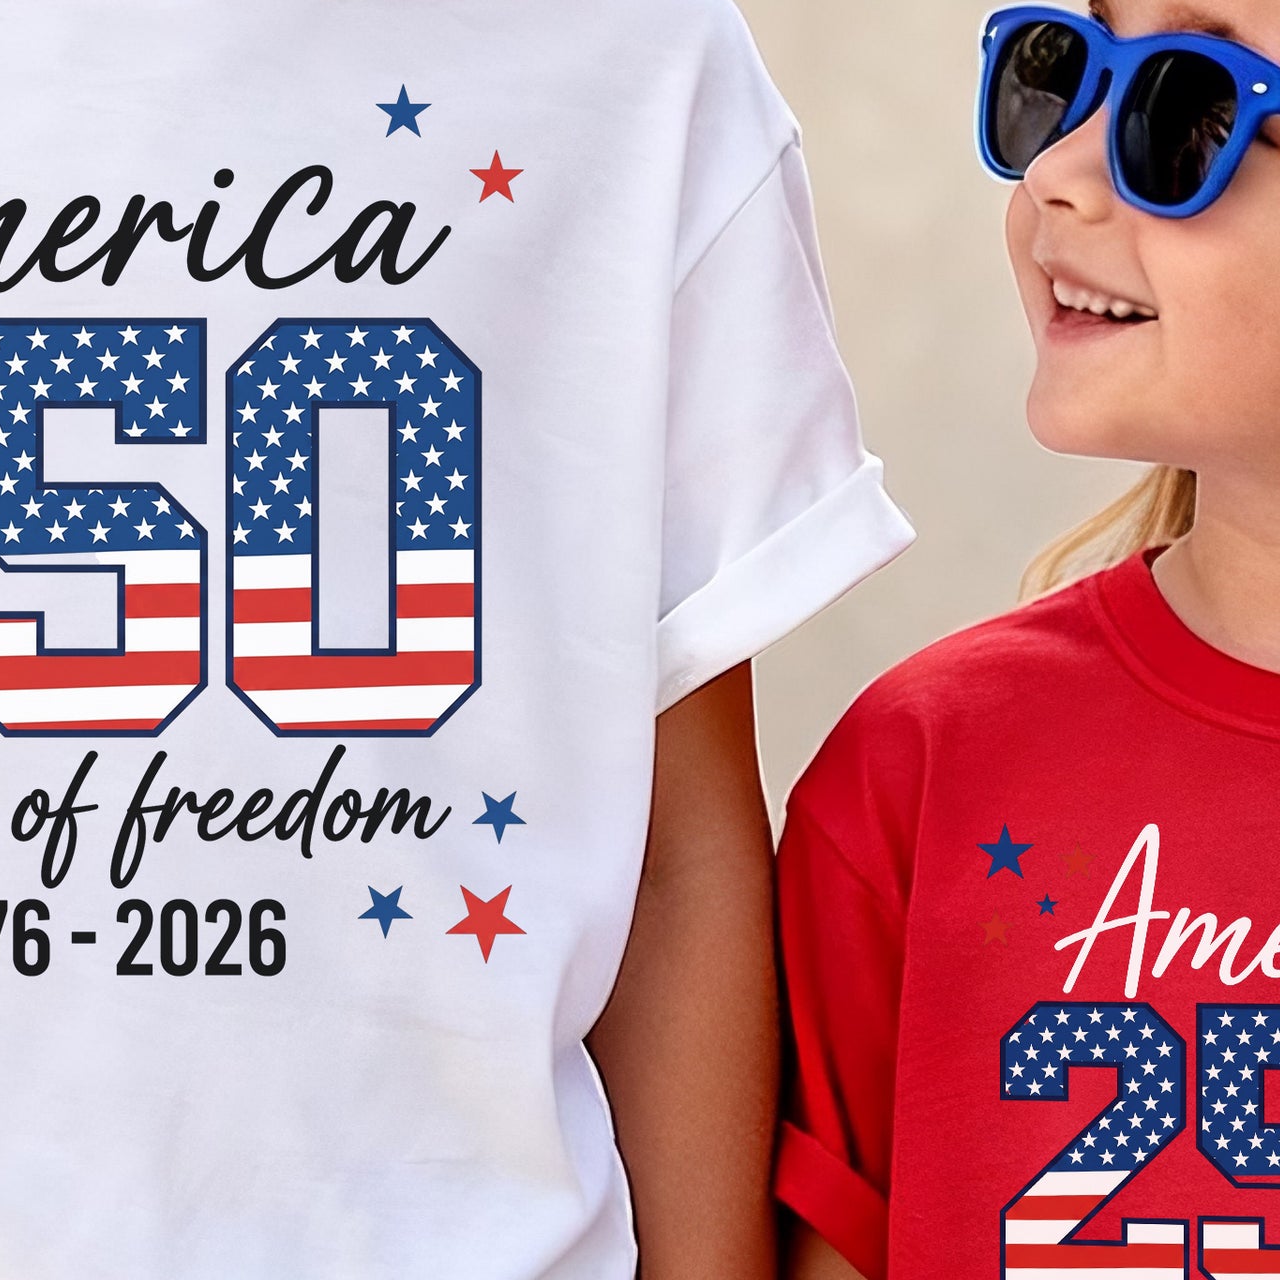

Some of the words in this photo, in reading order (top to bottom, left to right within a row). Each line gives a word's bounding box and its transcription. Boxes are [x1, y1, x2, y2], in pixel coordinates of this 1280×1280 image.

[11, 750, 98, 890] of
[109, 744, 451, 889] freedom
[71, 932, 96, 948] -
[117, 899, 287, 976] 2026
